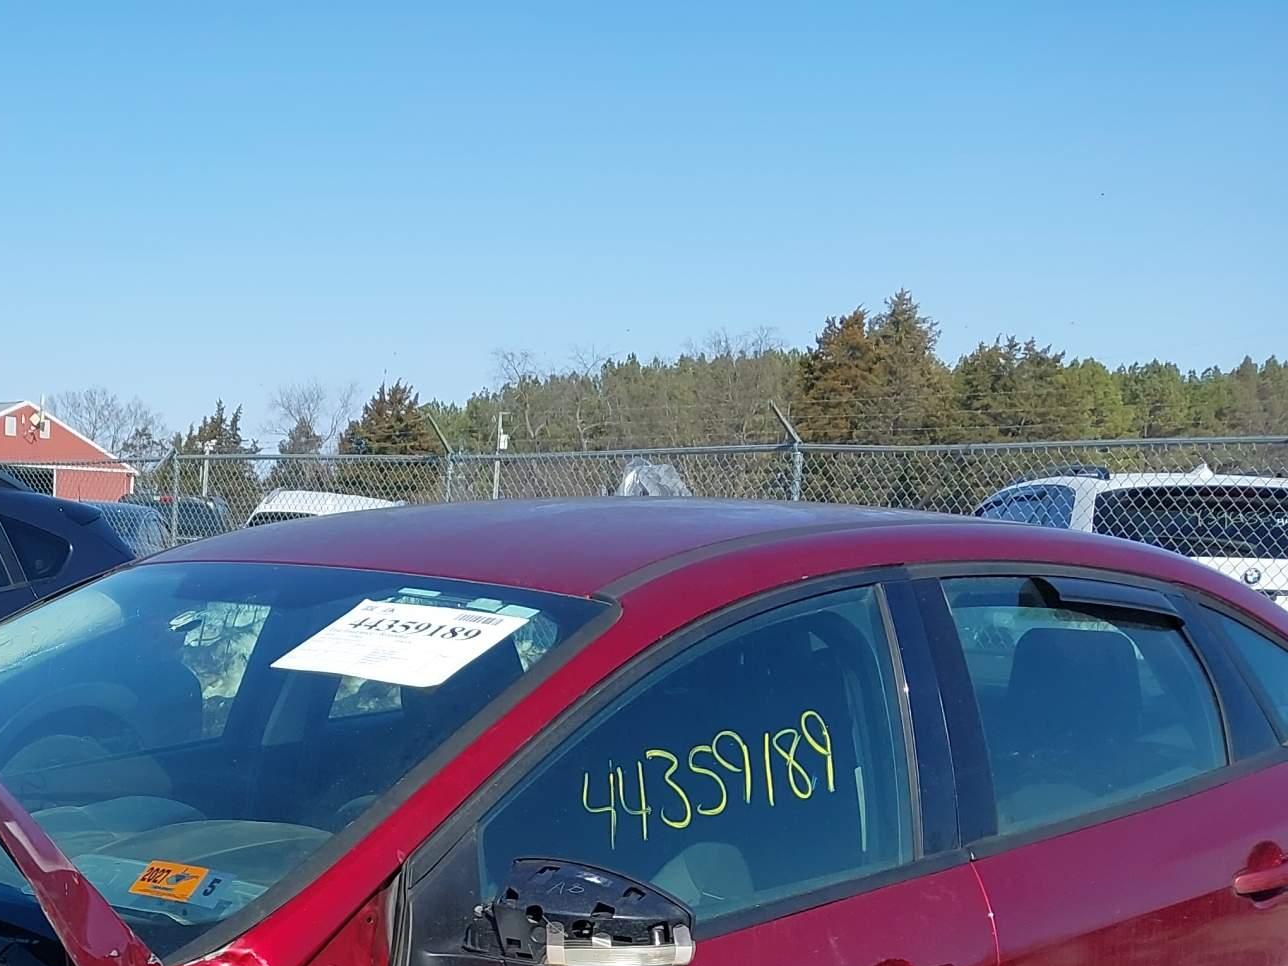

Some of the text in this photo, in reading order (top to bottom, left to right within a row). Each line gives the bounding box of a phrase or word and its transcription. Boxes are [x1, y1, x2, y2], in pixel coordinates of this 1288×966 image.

[348, 617, 482, 641] 44359189
[583, 710, 836, 850] 44359189
[140, 866, 172, 885] 2027
[202, 878, 222, 897] 5
